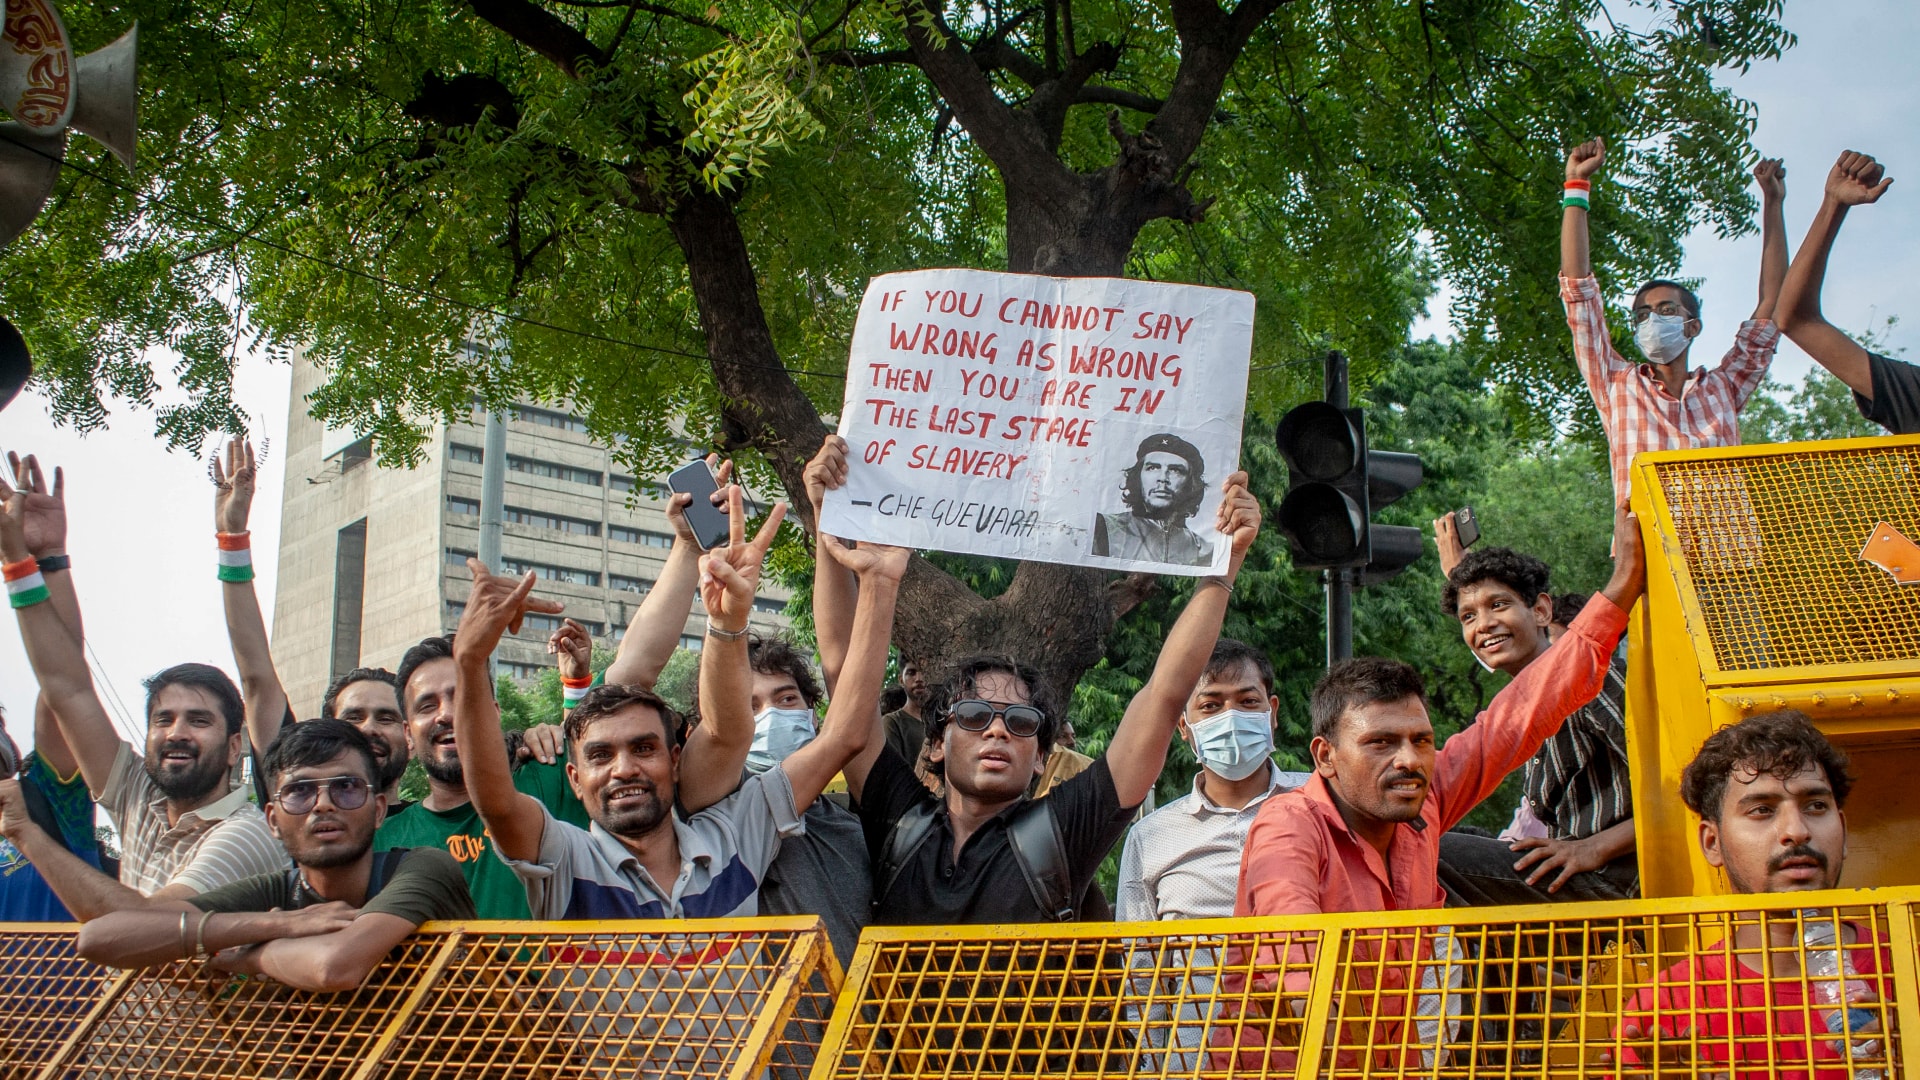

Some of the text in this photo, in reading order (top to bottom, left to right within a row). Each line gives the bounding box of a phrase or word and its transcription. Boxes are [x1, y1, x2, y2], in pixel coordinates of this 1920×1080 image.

[880, 289, 1194, 345] IF YOU CANNOT SAY
[890, 322, 1183, 388] WRONG AS WRONG
[869, 363, 1165, 415] THEN YOU ARE IN
[865, 398, 1096, 447] THE LAST STAGE
[864, 438, 1028, 480] OF SLAVERY
[931, 498, 1040, 538] GUEVARA
